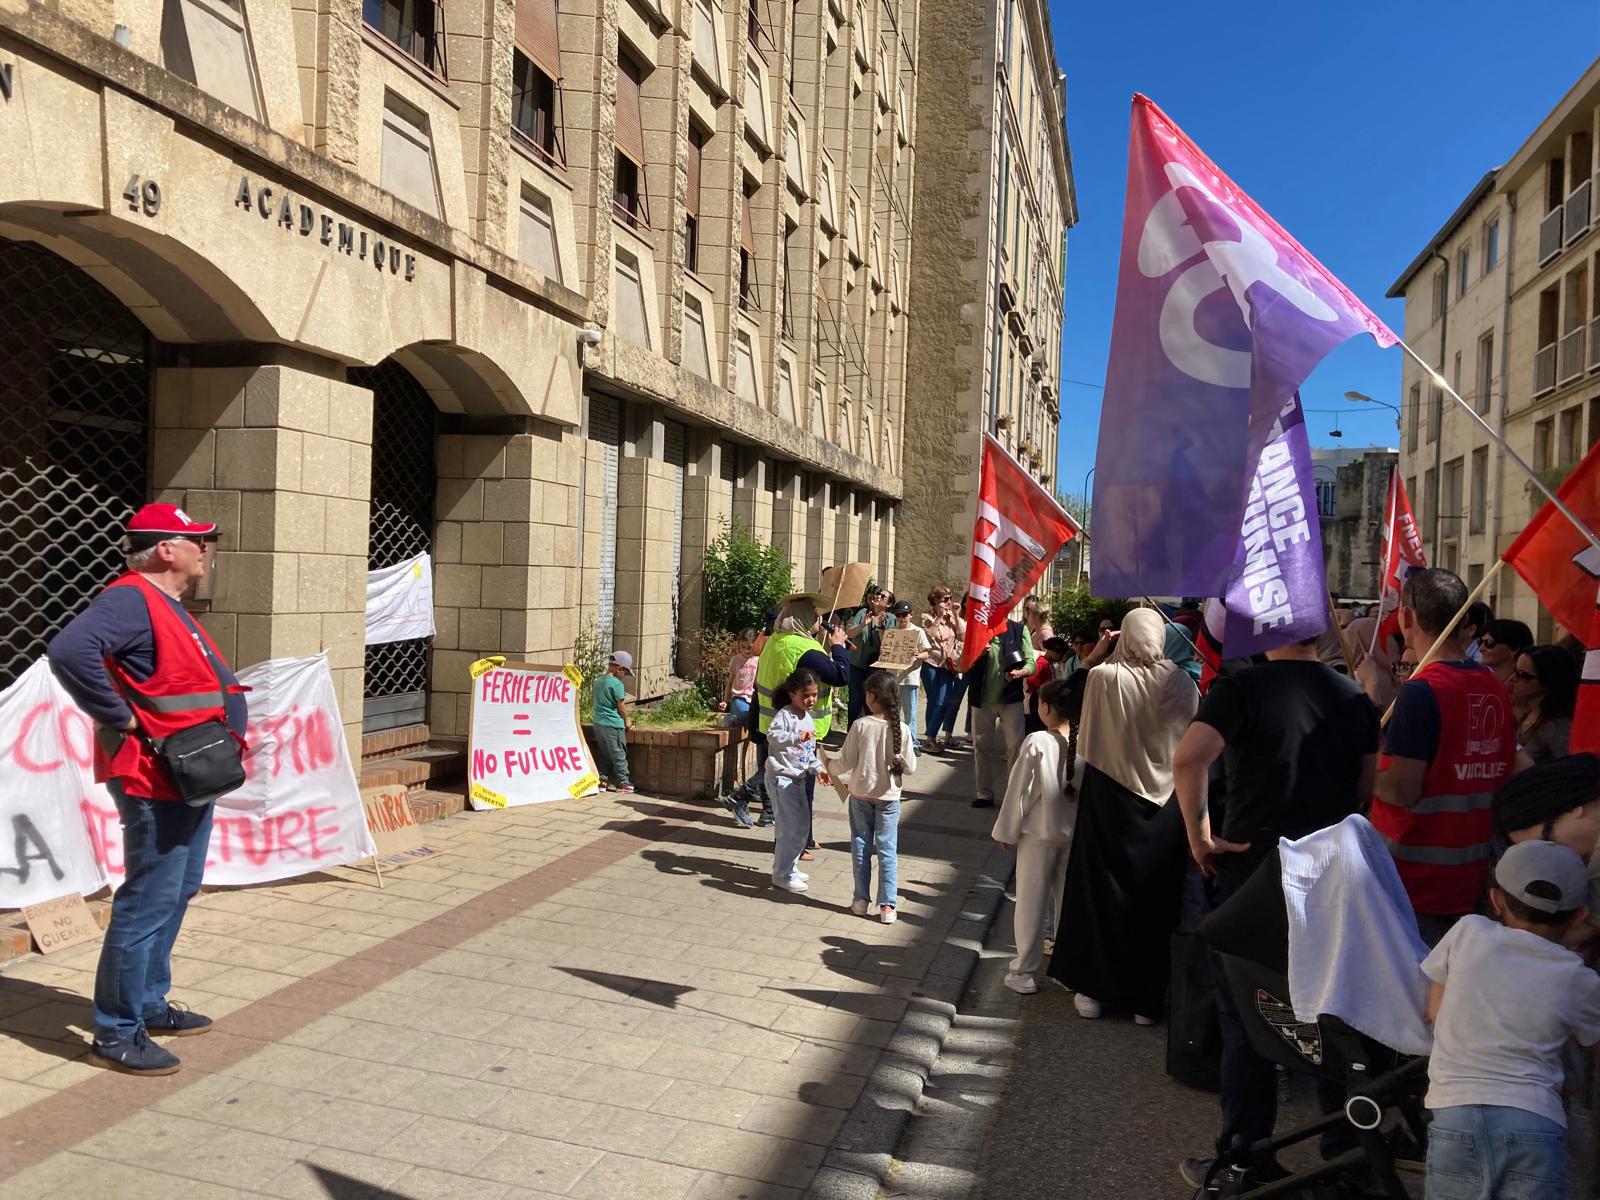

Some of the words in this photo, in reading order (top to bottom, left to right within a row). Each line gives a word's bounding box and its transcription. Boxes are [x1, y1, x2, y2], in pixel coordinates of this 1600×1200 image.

[123, 175, 161, 217] 49
[234, 176, 416, 282] ACADEMIQUE
[482, 671, 571, 704] FERMETURE
[472, 748, 498, 781] NO
[504, 746, 583, 778] FUTURE
[41, 923, 92, 948] GUERRE
[53, 915, 73, 929] NO
